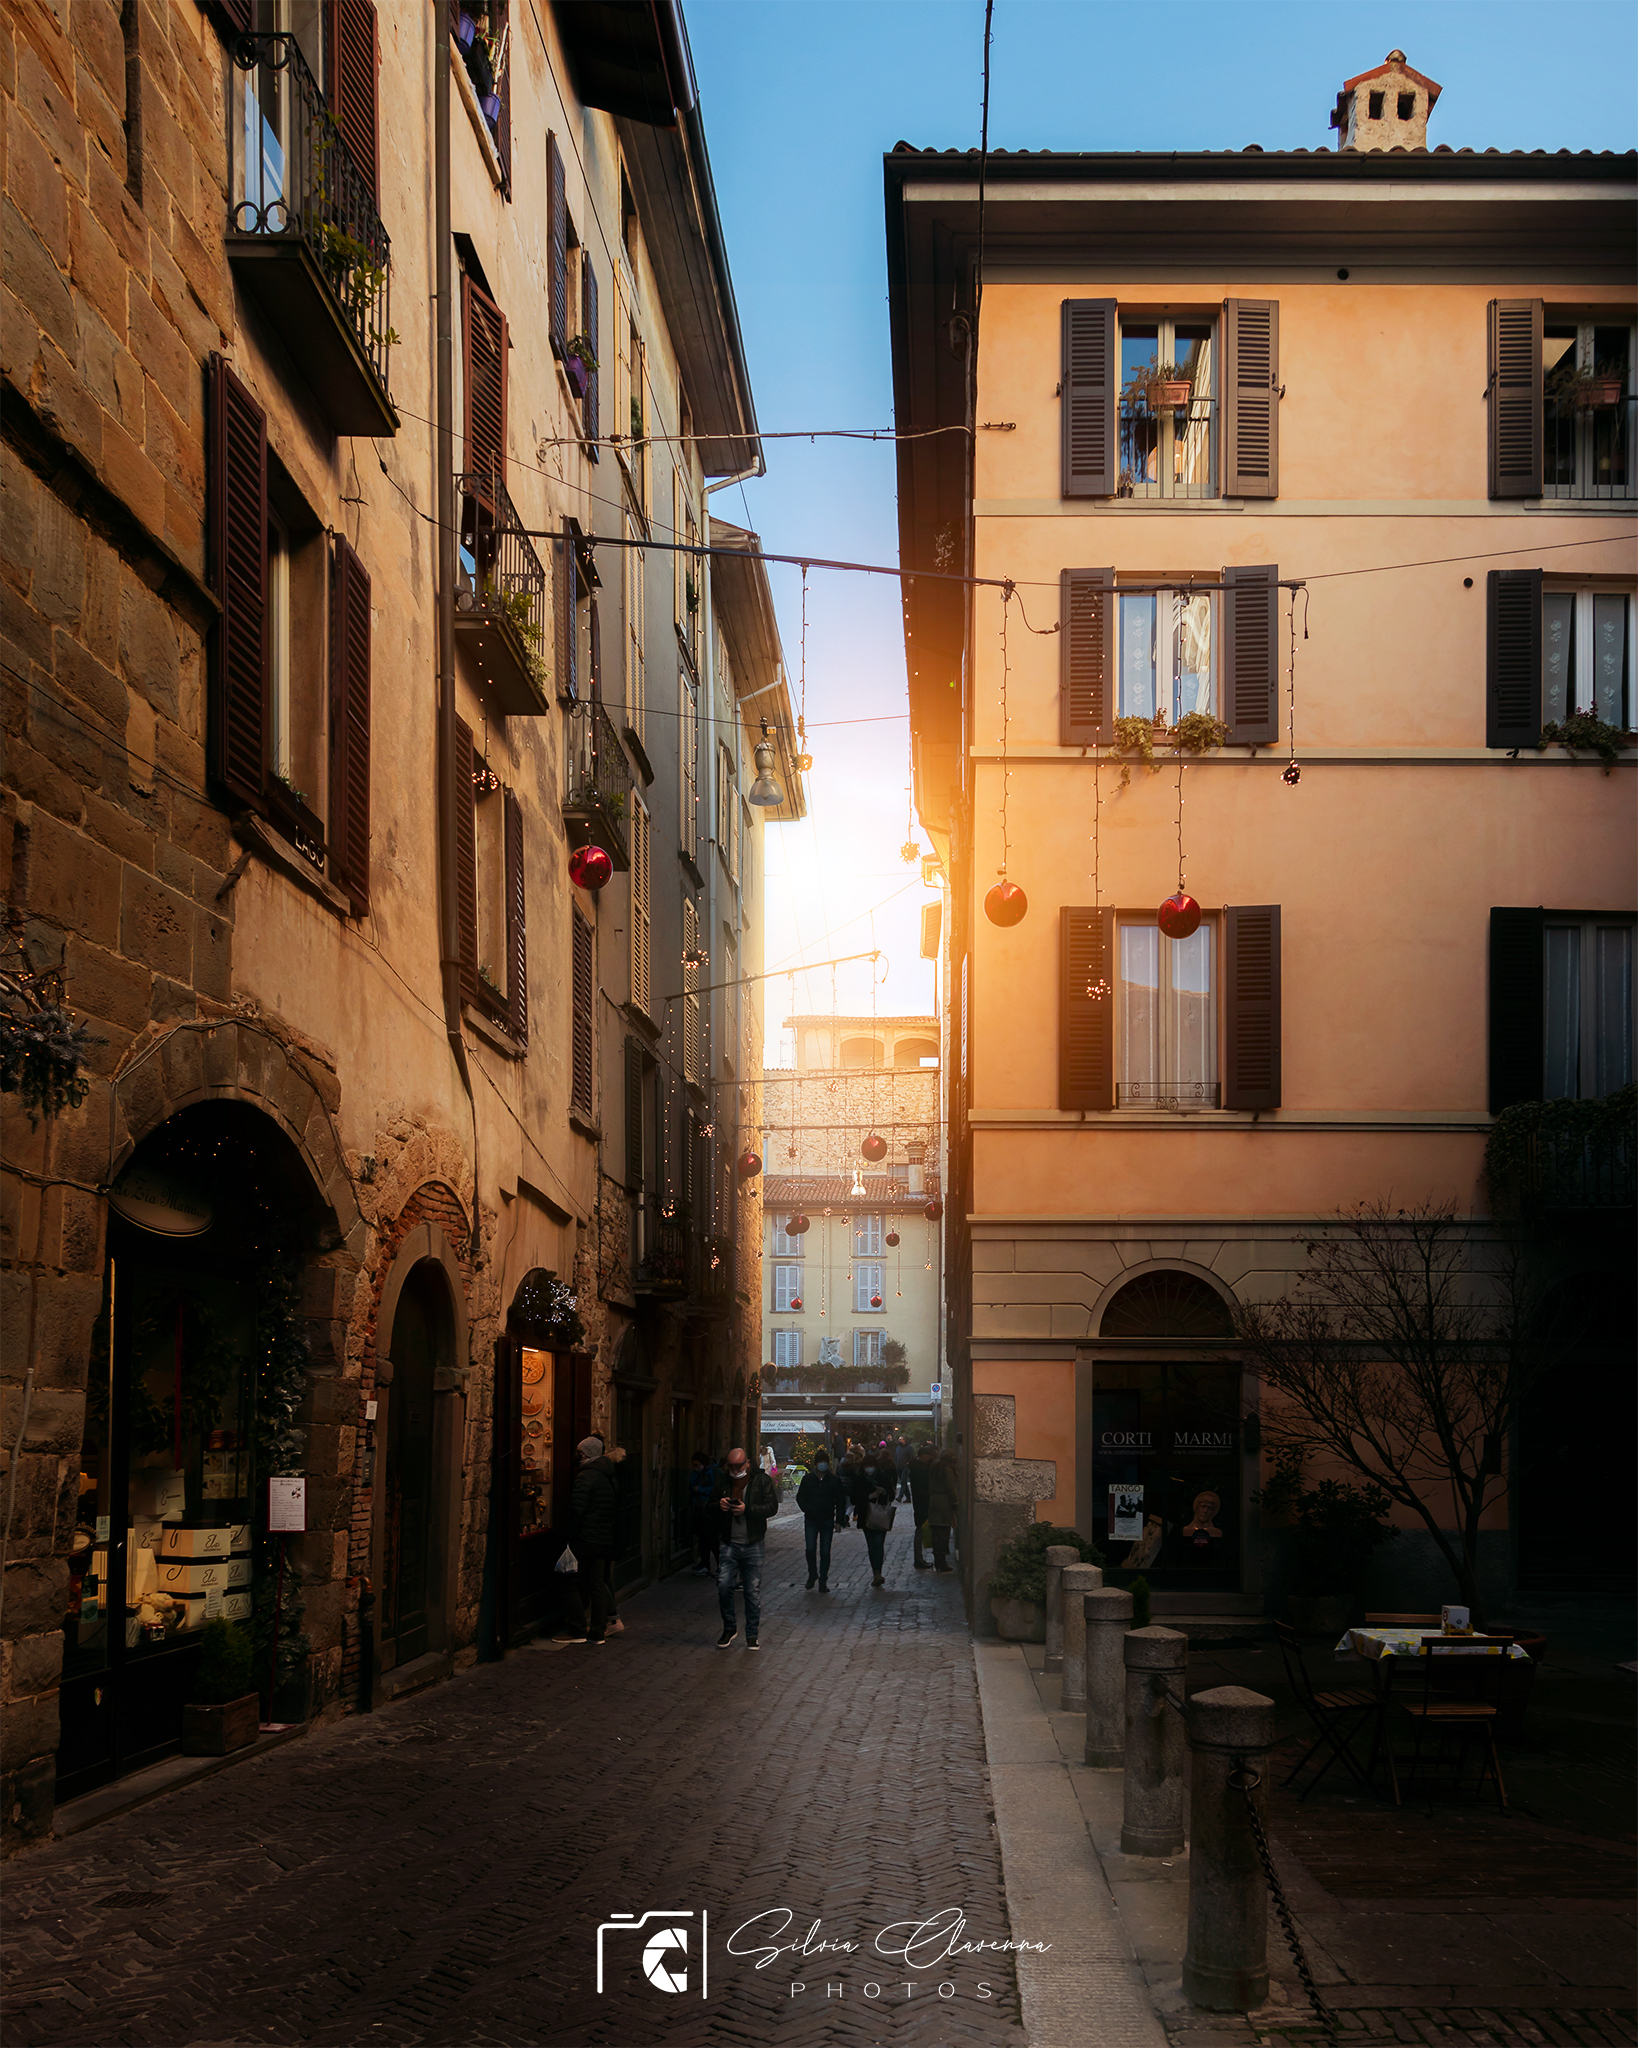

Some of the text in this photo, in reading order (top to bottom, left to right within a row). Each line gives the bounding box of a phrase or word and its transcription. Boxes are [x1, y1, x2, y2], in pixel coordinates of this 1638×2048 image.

[295, 825, 324, 868] LAGO
[131, 1176, 158, 1205] Zia
[1101, 1431, 1233, 1445] CORTI MARMI
[1110, 1484, 1141, 1493] TANGO
